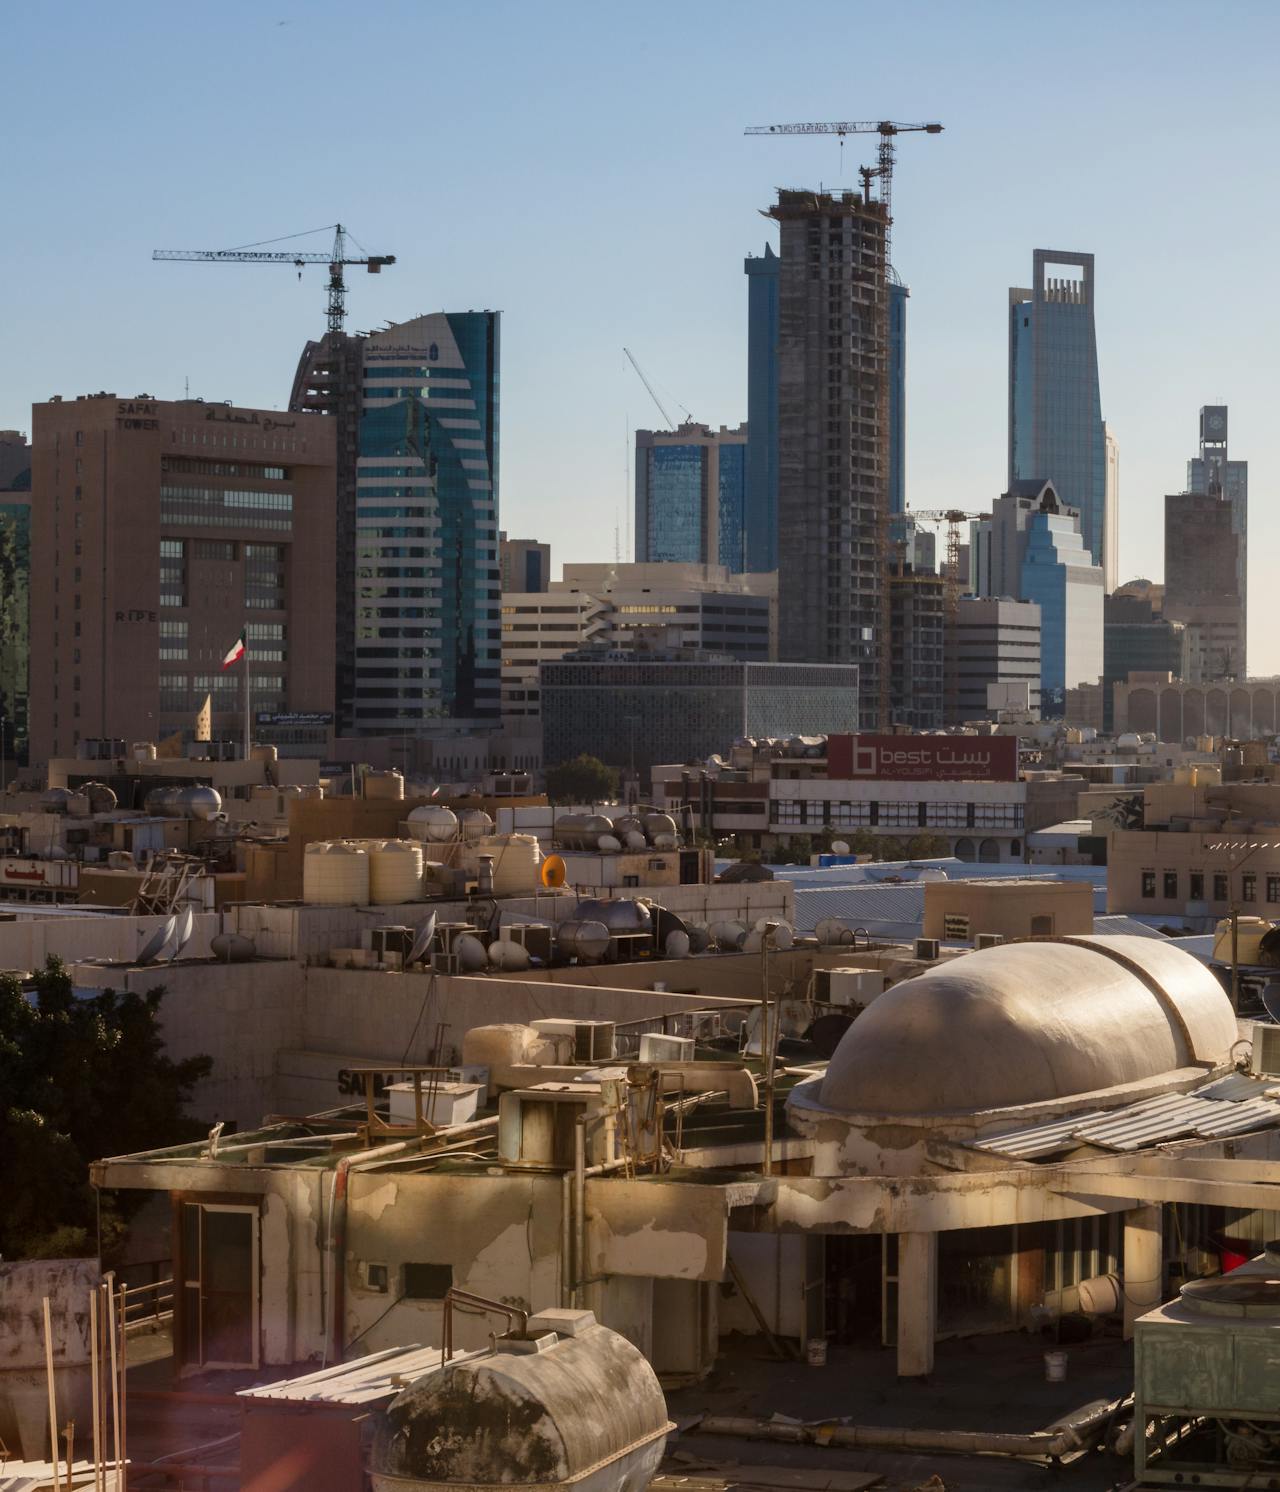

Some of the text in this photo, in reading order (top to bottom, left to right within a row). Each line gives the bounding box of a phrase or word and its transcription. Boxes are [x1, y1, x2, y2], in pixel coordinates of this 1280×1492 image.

[118, 402, 160, 415] SAFAT
[116, 417, 161, 431] TOWER
[880, 747, 932, 764] best
[936, 746, 990, 768] بست
